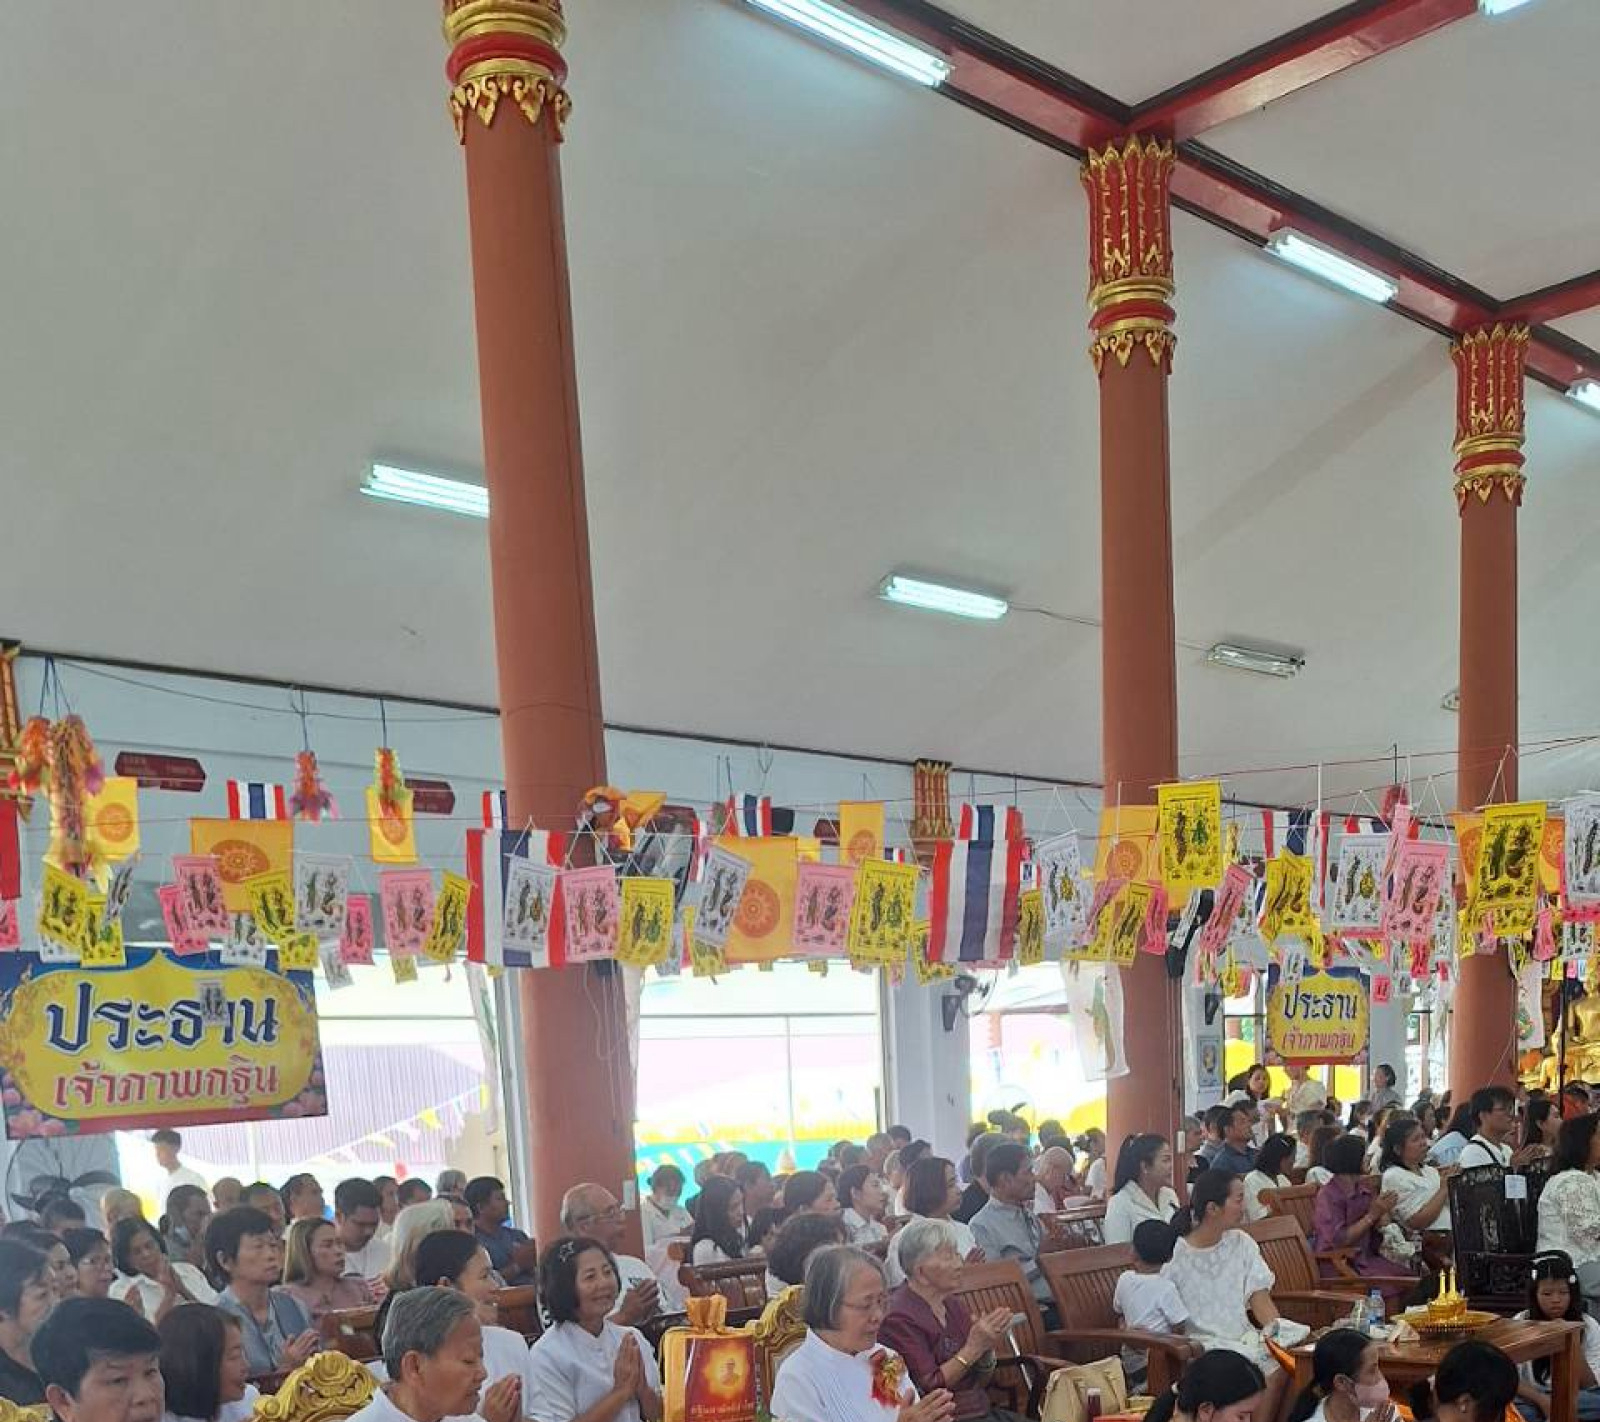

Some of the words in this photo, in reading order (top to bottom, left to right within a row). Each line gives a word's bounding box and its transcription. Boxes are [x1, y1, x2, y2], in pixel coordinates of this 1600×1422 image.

[46, 982, 278, 1052] ประธาน
[1284, 984, 1358, 1019] ประธาน
[54, 1055, 279, 1107] เจ้าภาพกฐิน
